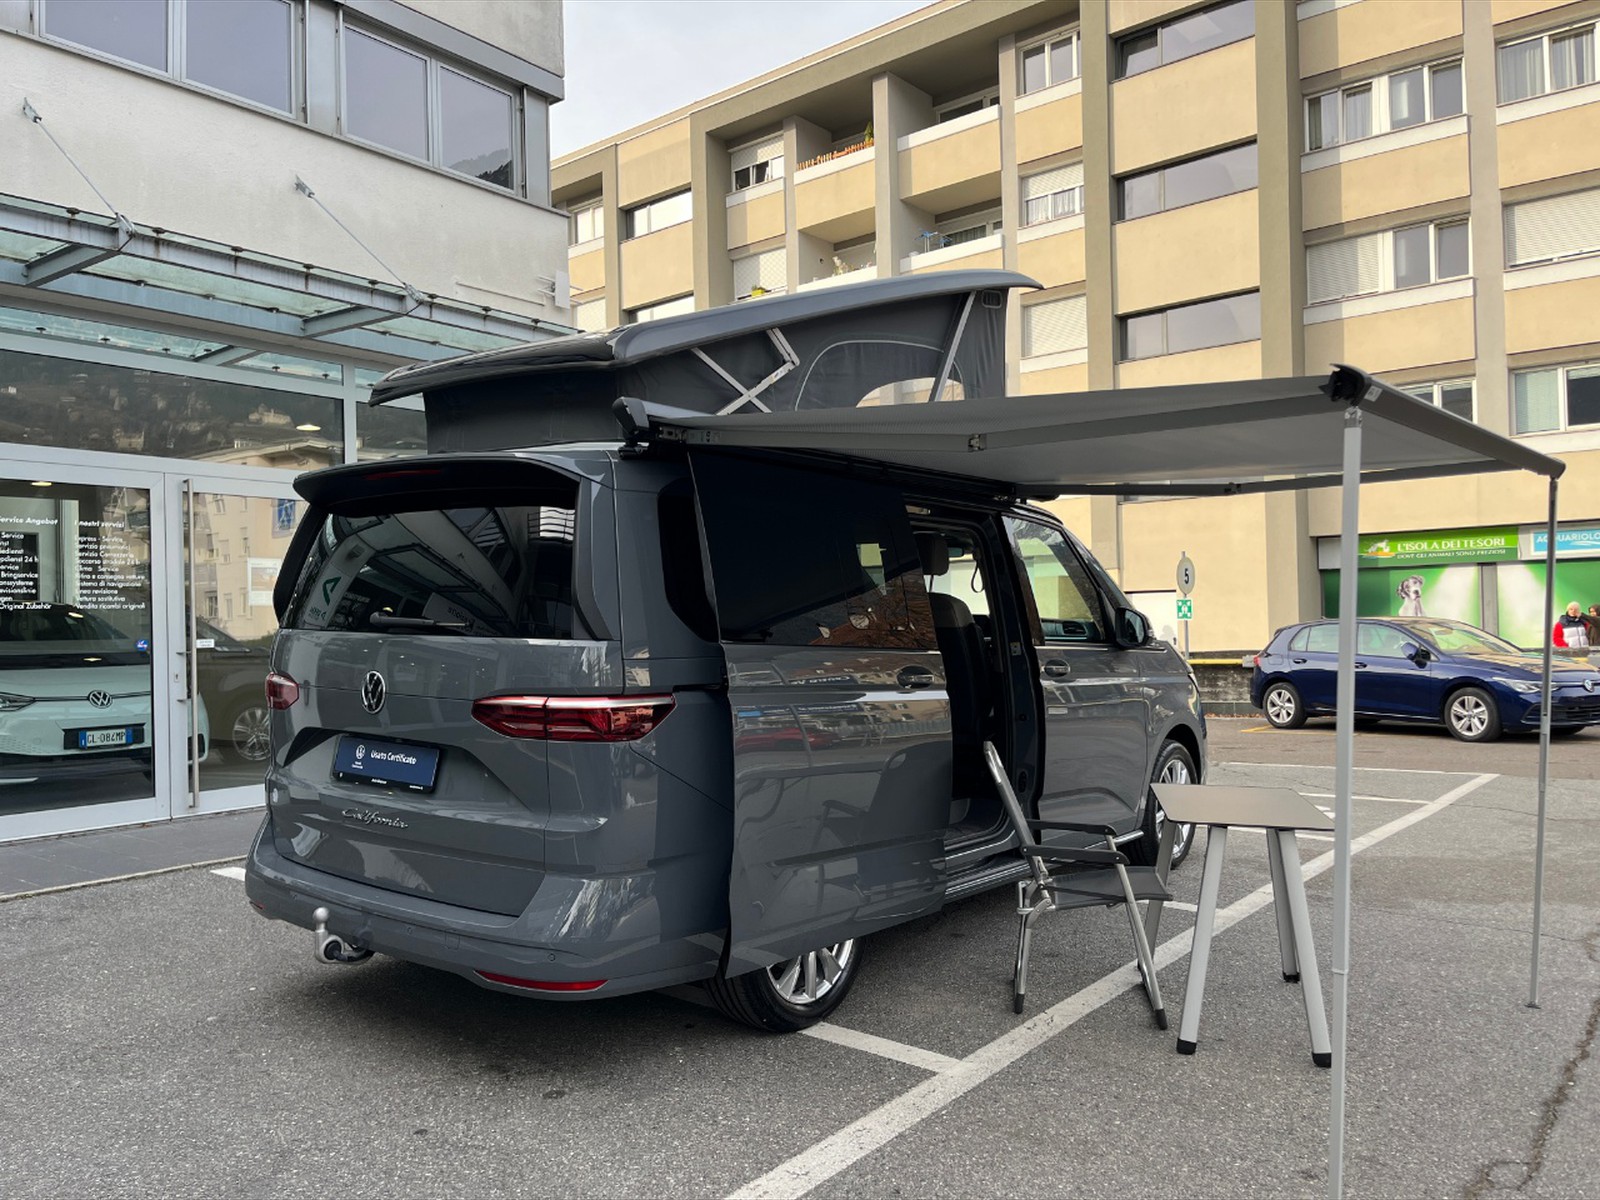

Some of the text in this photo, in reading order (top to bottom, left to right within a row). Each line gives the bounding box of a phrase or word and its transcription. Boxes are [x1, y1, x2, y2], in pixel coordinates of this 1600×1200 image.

[25, 517, 58, 525] Angebot
[1, 532, 24, 540] Service
[1462, 537, 1505, 548] TESORI
[1, 571, 39, 579] Bringservice
[1184, 568, 1190, 584] 5
[27, 602, 52, 610] Zubehör
[74, 602, 98, 610] Vendita
[122, 602, 146, 610] originali
[387, 752, 417, 765] Certificato
[342, 808, 409, 828] California
